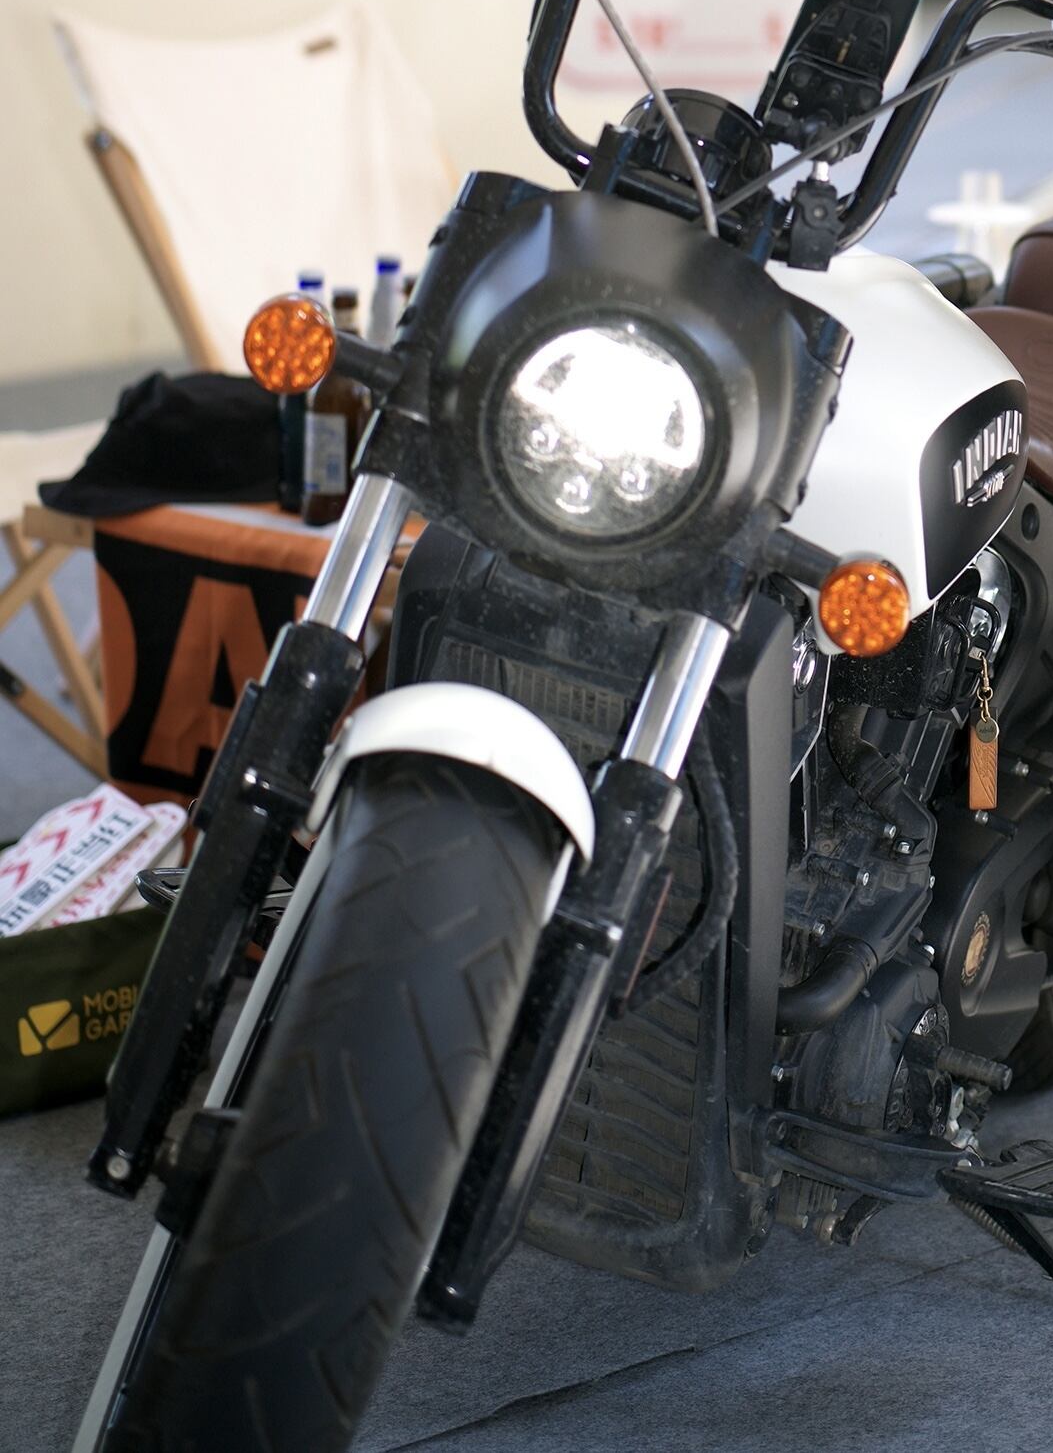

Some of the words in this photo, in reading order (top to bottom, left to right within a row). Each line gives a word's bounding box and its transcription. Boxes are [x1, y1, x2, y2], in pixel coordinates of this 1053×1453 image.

[953, 409, 1022, 504] INDIAN
[0, 810, 137, 938] 玩家正当红
[85, 1010, 132, 1040] GAR
